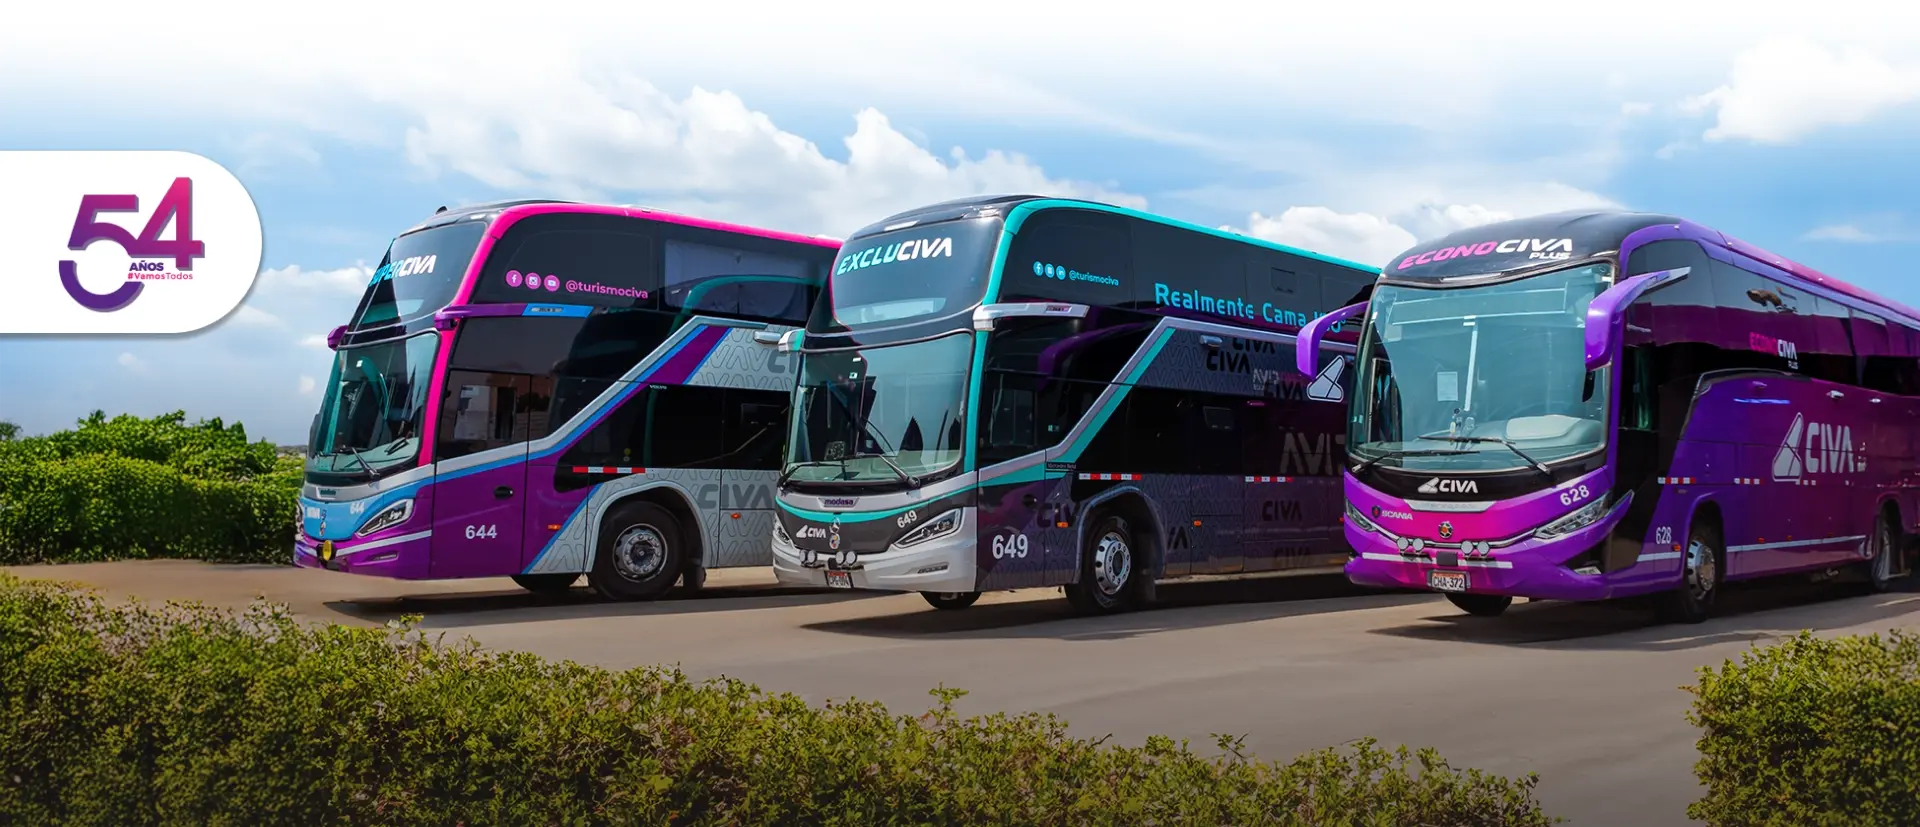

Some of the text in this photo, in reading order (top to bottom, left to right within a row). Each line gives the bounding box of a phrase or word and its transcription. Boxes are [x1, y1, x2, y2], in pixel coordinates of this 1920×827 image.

[836, 237, 953, 276] EXCLUCIVA
[1397, 238, 1573, 270] ECONOCIVA
[1529, 251, 1571, 260] PLUS
[1068, 269, 1120, 287] @turismociva
[565, 279, 649, 299] @turismociva
[1154, 282, 1255, 320] Realmente
[1262, 302, 1307, 328] Cama
[1206, 349, 1251, 374] CIVA
[1805, 422, 1855, 473] CIVA
[1438, 480, 1478, 494] CIVA
[1560, 485, 1590, 506] 628
[698, 484, 772, 510] CIVA
[824, 498, 854, 506] modasa
[350, 501, 364, 515] 644
[1381, 510, 1414, 521] SCANIA
[897, 510, 918, 529] 649
[465, 524, 498, 540] 644
[808, 526, 827, 538] CIVA
[1656, 526, 1672, 545] 628
[992, 534, 1029, 560] 649
[1433, 576, 1464, 588] CHA-372
